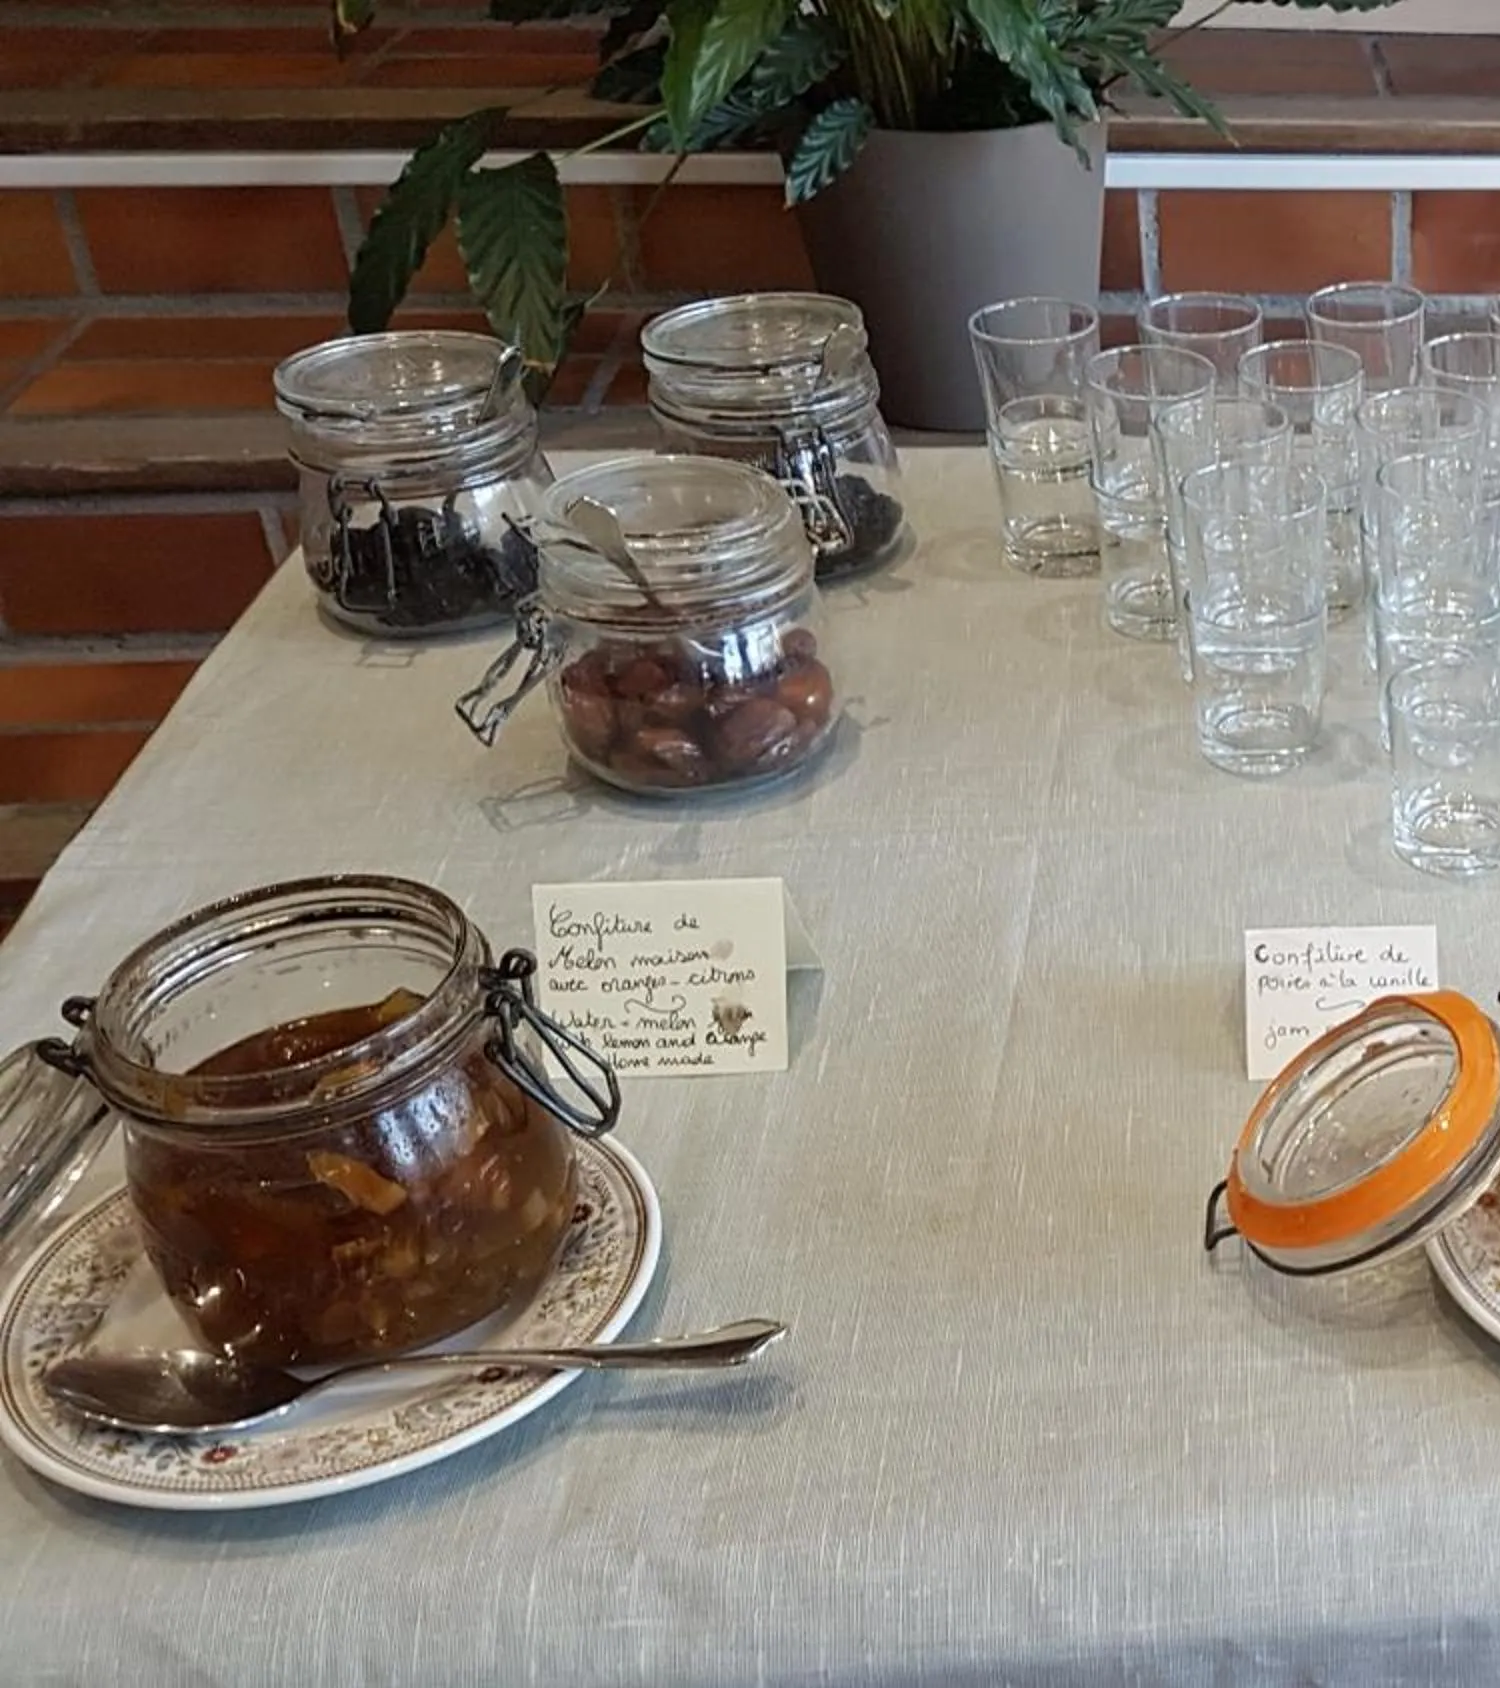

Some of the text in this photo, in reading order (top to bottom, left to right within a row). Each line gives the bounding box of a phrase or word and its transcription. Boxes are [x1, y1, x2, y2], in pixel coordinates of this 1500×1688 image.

[549, 904, 700, 952] Confiture de
[630, 948, 710, 968] maison
[1254, 941, 1410, 971] Confiture de
[549, 979, 589, 992] avec
[655, 1033, 696, 1049] and
[1264, 1017, 1310, 1050] jam
[657, 1051, 715, 1067] made
